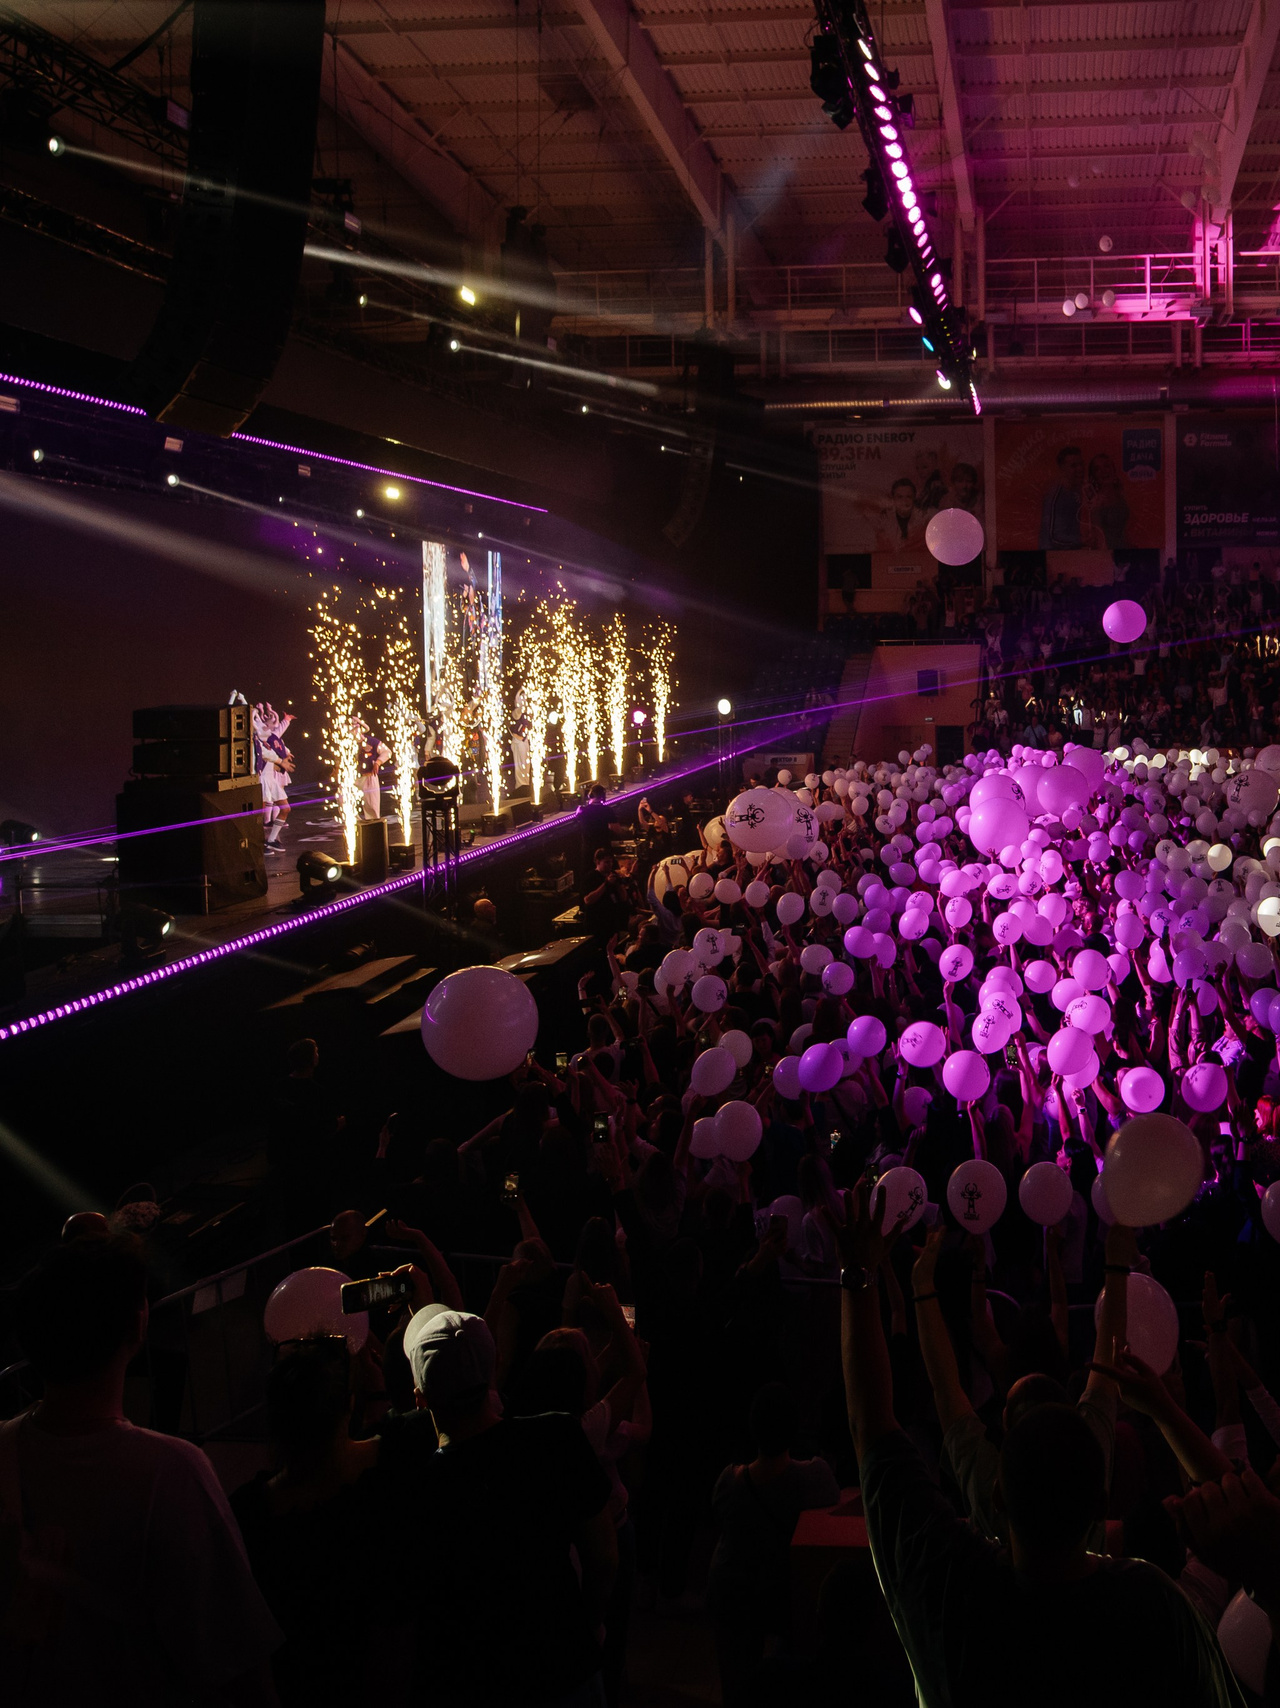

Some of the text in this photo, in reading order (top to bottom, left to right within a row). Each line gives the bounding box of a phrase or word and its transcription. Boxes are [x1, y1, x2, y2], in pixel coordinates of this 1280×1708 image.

[818, 432, 915, 446] РАДИО ENERGY
[1126, 438, 1157, 449] РАДИО
[818, 446, 881, 461] 89.3FM
[1129, 452, 1154, 462] ДАЧА
[819, 461, 856, 471] СЛУШАЙ
[1183, 512, 1250, 525] ЗДОРОВЬЕ
[1190, 527, 1253, 537] ВИТАМИНЫ
